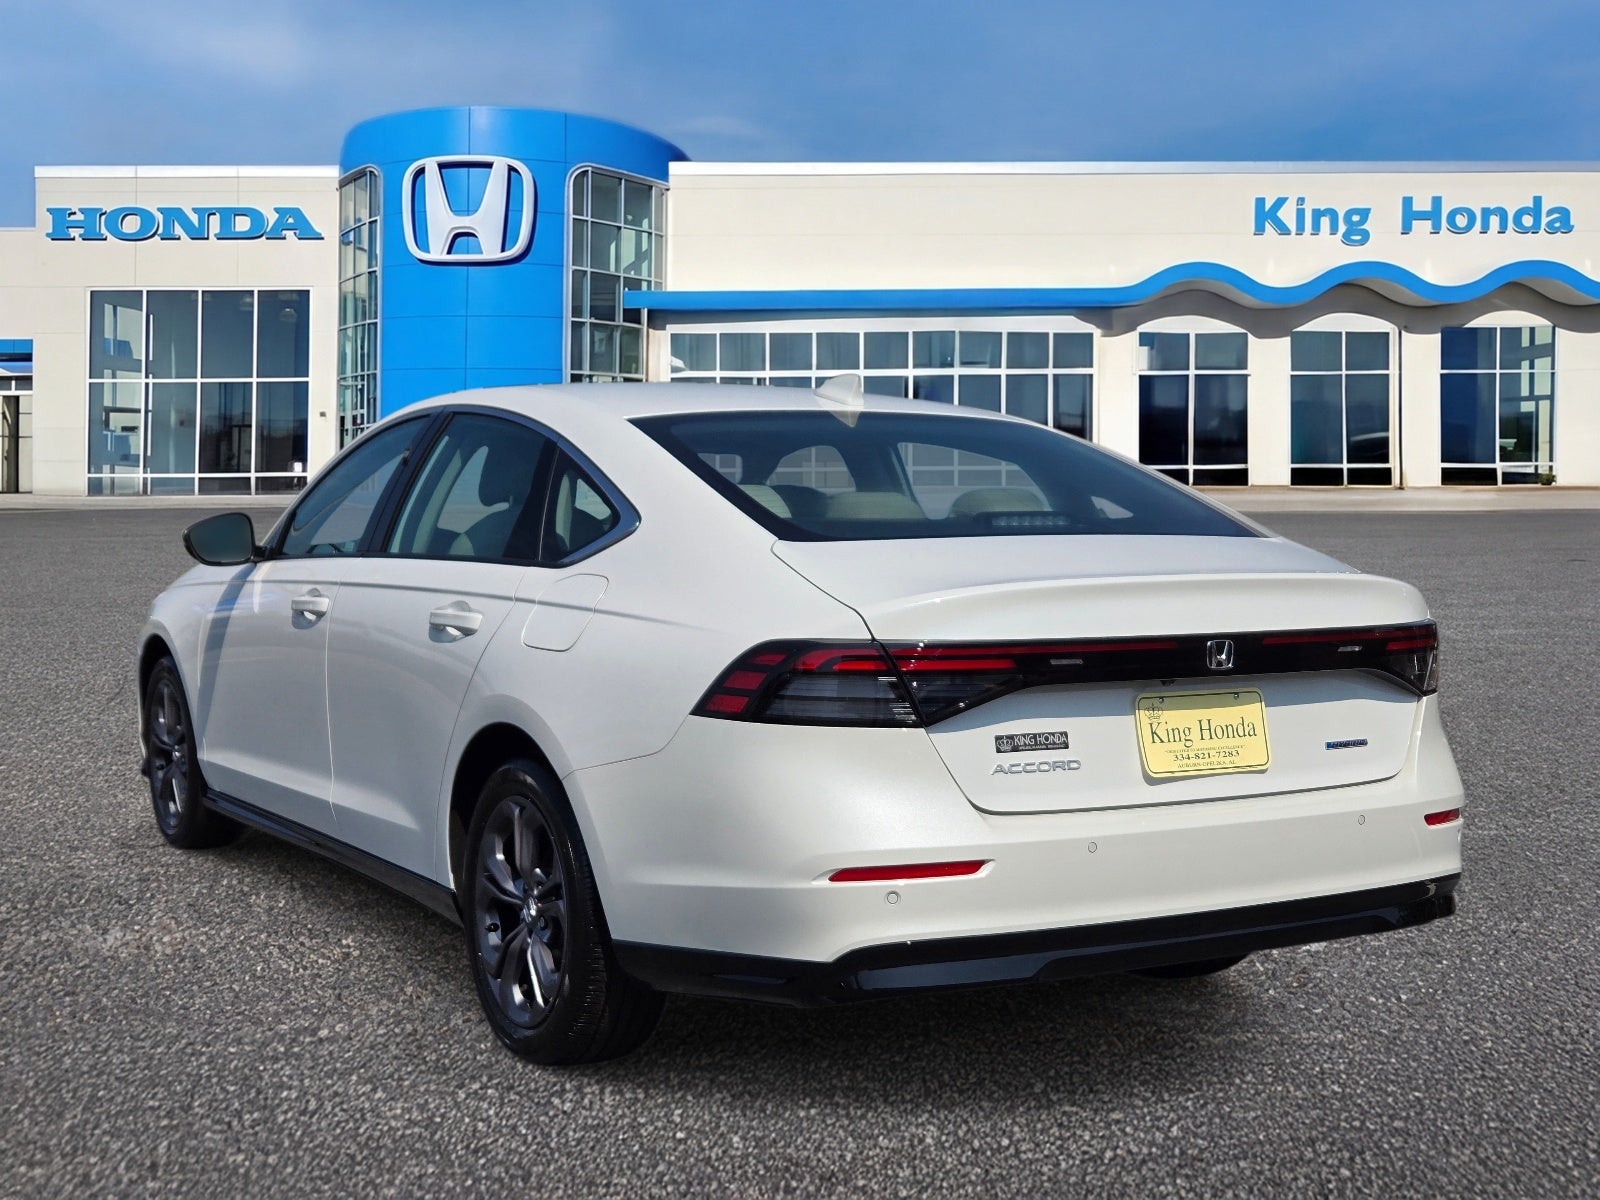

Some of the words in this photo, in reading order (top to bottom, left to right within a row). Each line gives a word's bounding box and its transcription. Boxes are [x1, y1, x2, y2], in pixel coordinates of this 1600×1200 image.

[46, 205, 325, 241] HONDA
[1253, 196, 1372, 246] King
[1400, 195, 1575, 235] Honda
[1014, 734, 1035, 746] KING
[1036, 732, 1068, 744] HONDA
[1148, 720, 1194, 748] King
[1197, 716, 1257, 741] Honda
[990, 759, 1081, 775] ACCORD
[1173, 749, 1240, 762] 334-821-7283
